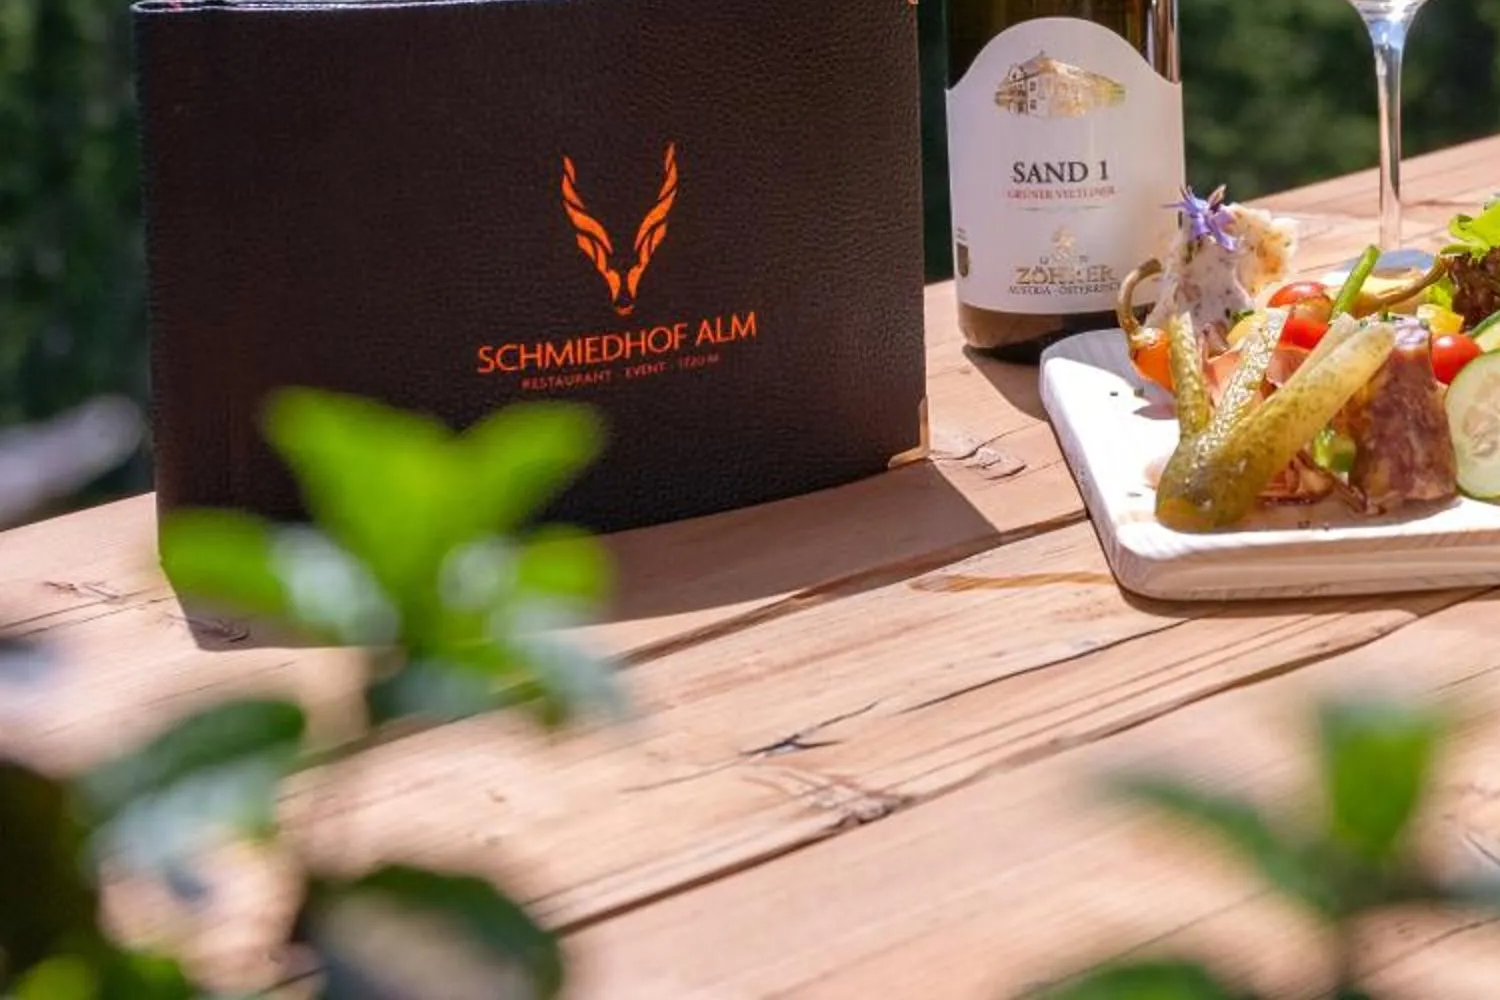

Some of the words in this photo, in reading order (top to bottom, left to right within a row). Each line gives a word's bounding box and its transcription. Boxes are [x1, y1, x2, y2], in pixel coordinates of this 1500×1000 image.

[1011, 160, 1089, 184] SAND
[1099, 160, 1109, 181] 1
[477, 322, 689, 374] SCHMIEDHOF
[695, 311, 758, 347] ALM
[521, 369, 612, 390] RESTAURANT
[625, 361, 668, 379] EVENT
